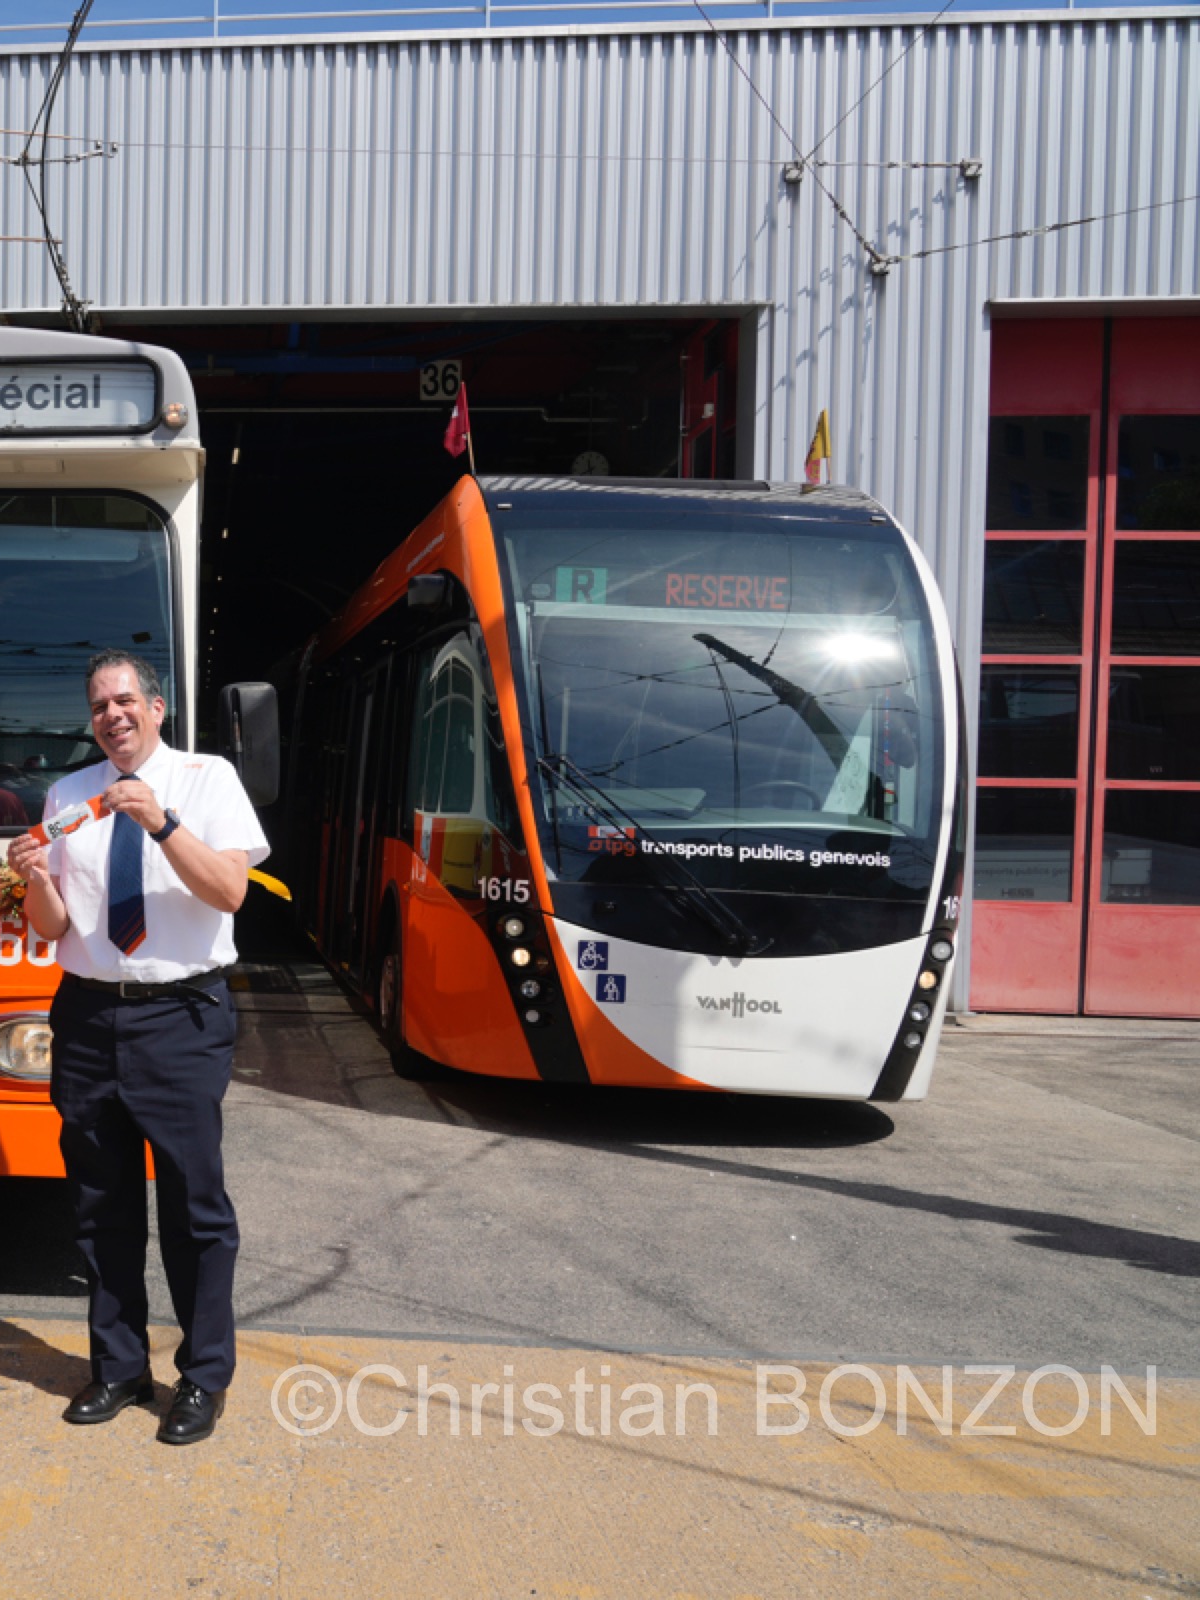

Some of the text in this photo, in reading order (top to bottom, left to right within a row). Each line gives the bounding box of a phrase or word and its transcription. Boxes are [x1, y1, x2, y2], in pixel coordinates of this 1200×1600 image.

[422, 363, 459, 397] 36
[571, 568, 596, 604] R
[665, 572, 788, 609] RESERVE
[641, 838, 733, 860] transports
[739, 843, 805, 863] publics
[809, 848, 891, 868] genevois
[477, 875, 531, 903] 1615
